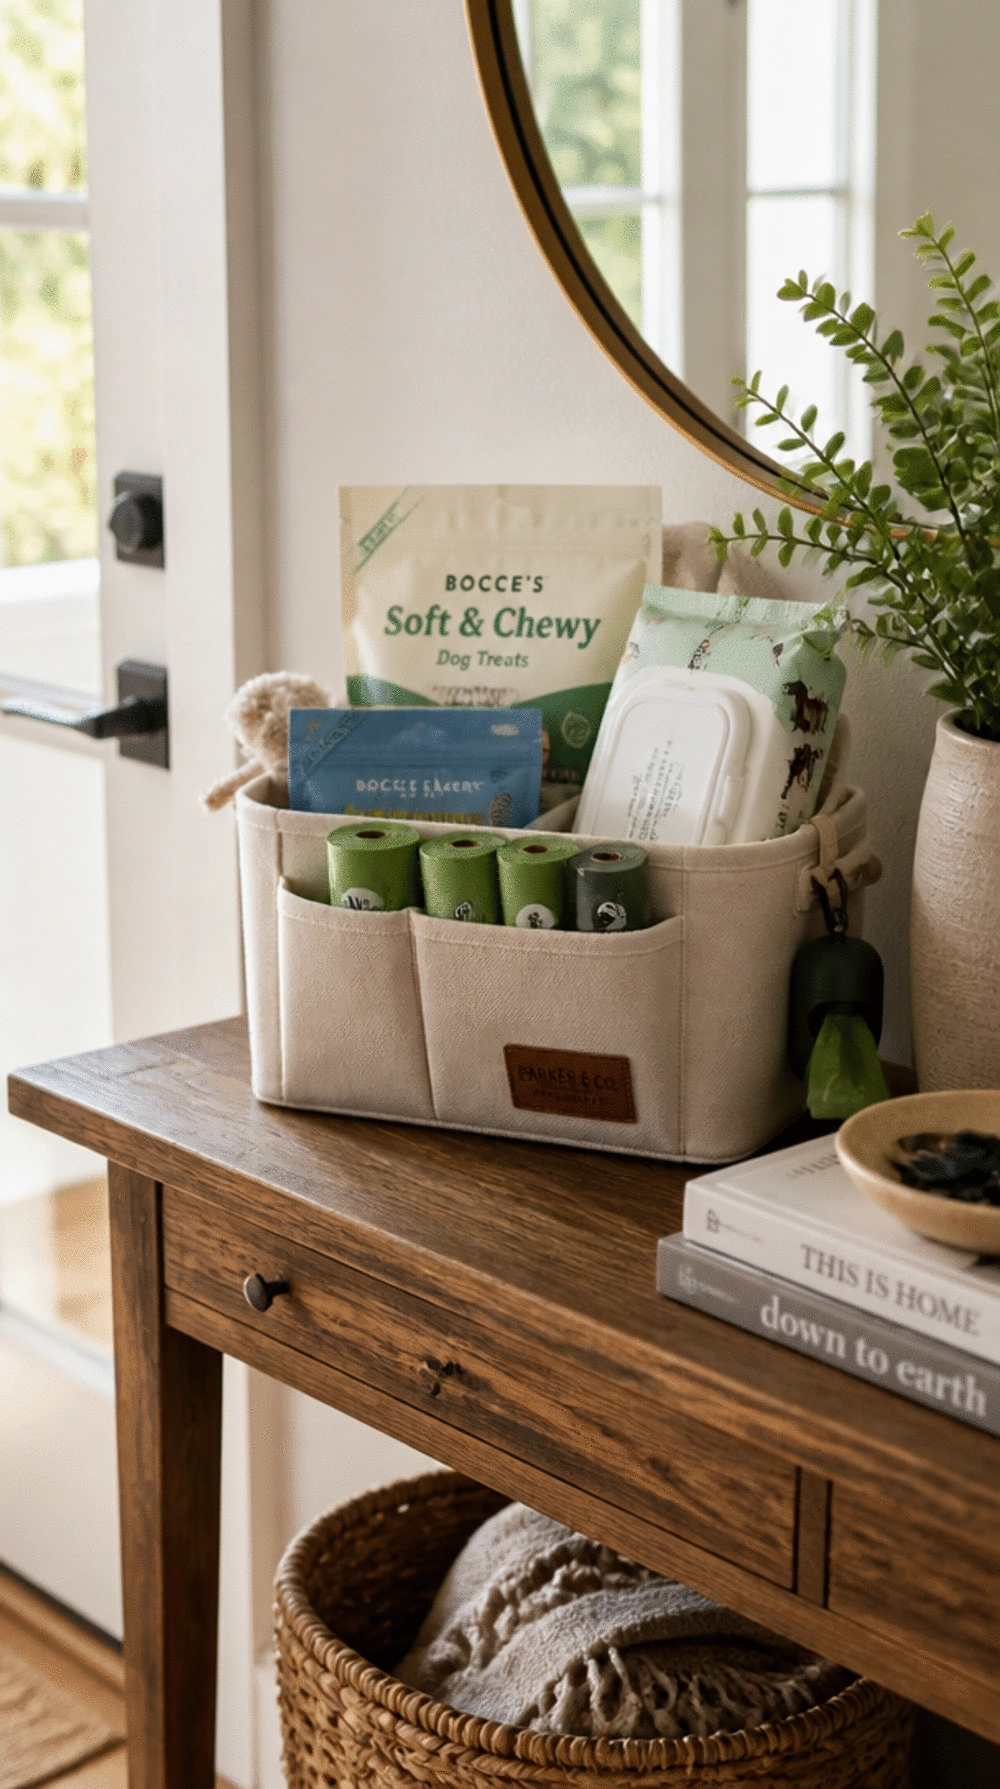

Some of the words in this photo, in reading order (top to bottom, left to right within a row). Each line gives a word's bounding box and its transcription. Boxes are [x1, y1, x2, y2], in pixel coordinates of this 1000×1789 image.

[445, 574, 544, 593] BOCCE'S
[384, 604, 451, 637] Soft
[458, 606, 485, 638] &
[493, 605, 602, 650] Chewy
[436, 649, 471, 671] Dog
[477, 650, 529, 668] Treats
[800, 1244, 861, 1288] THIS
[864, 1269, 891, 1300] IS
[896, 1279, 982, 1337] HOME
[759, 1295, 847, 1359] down
[855, 1337, 890, 1375] to
[896, 1360, 987, 1417] earth
